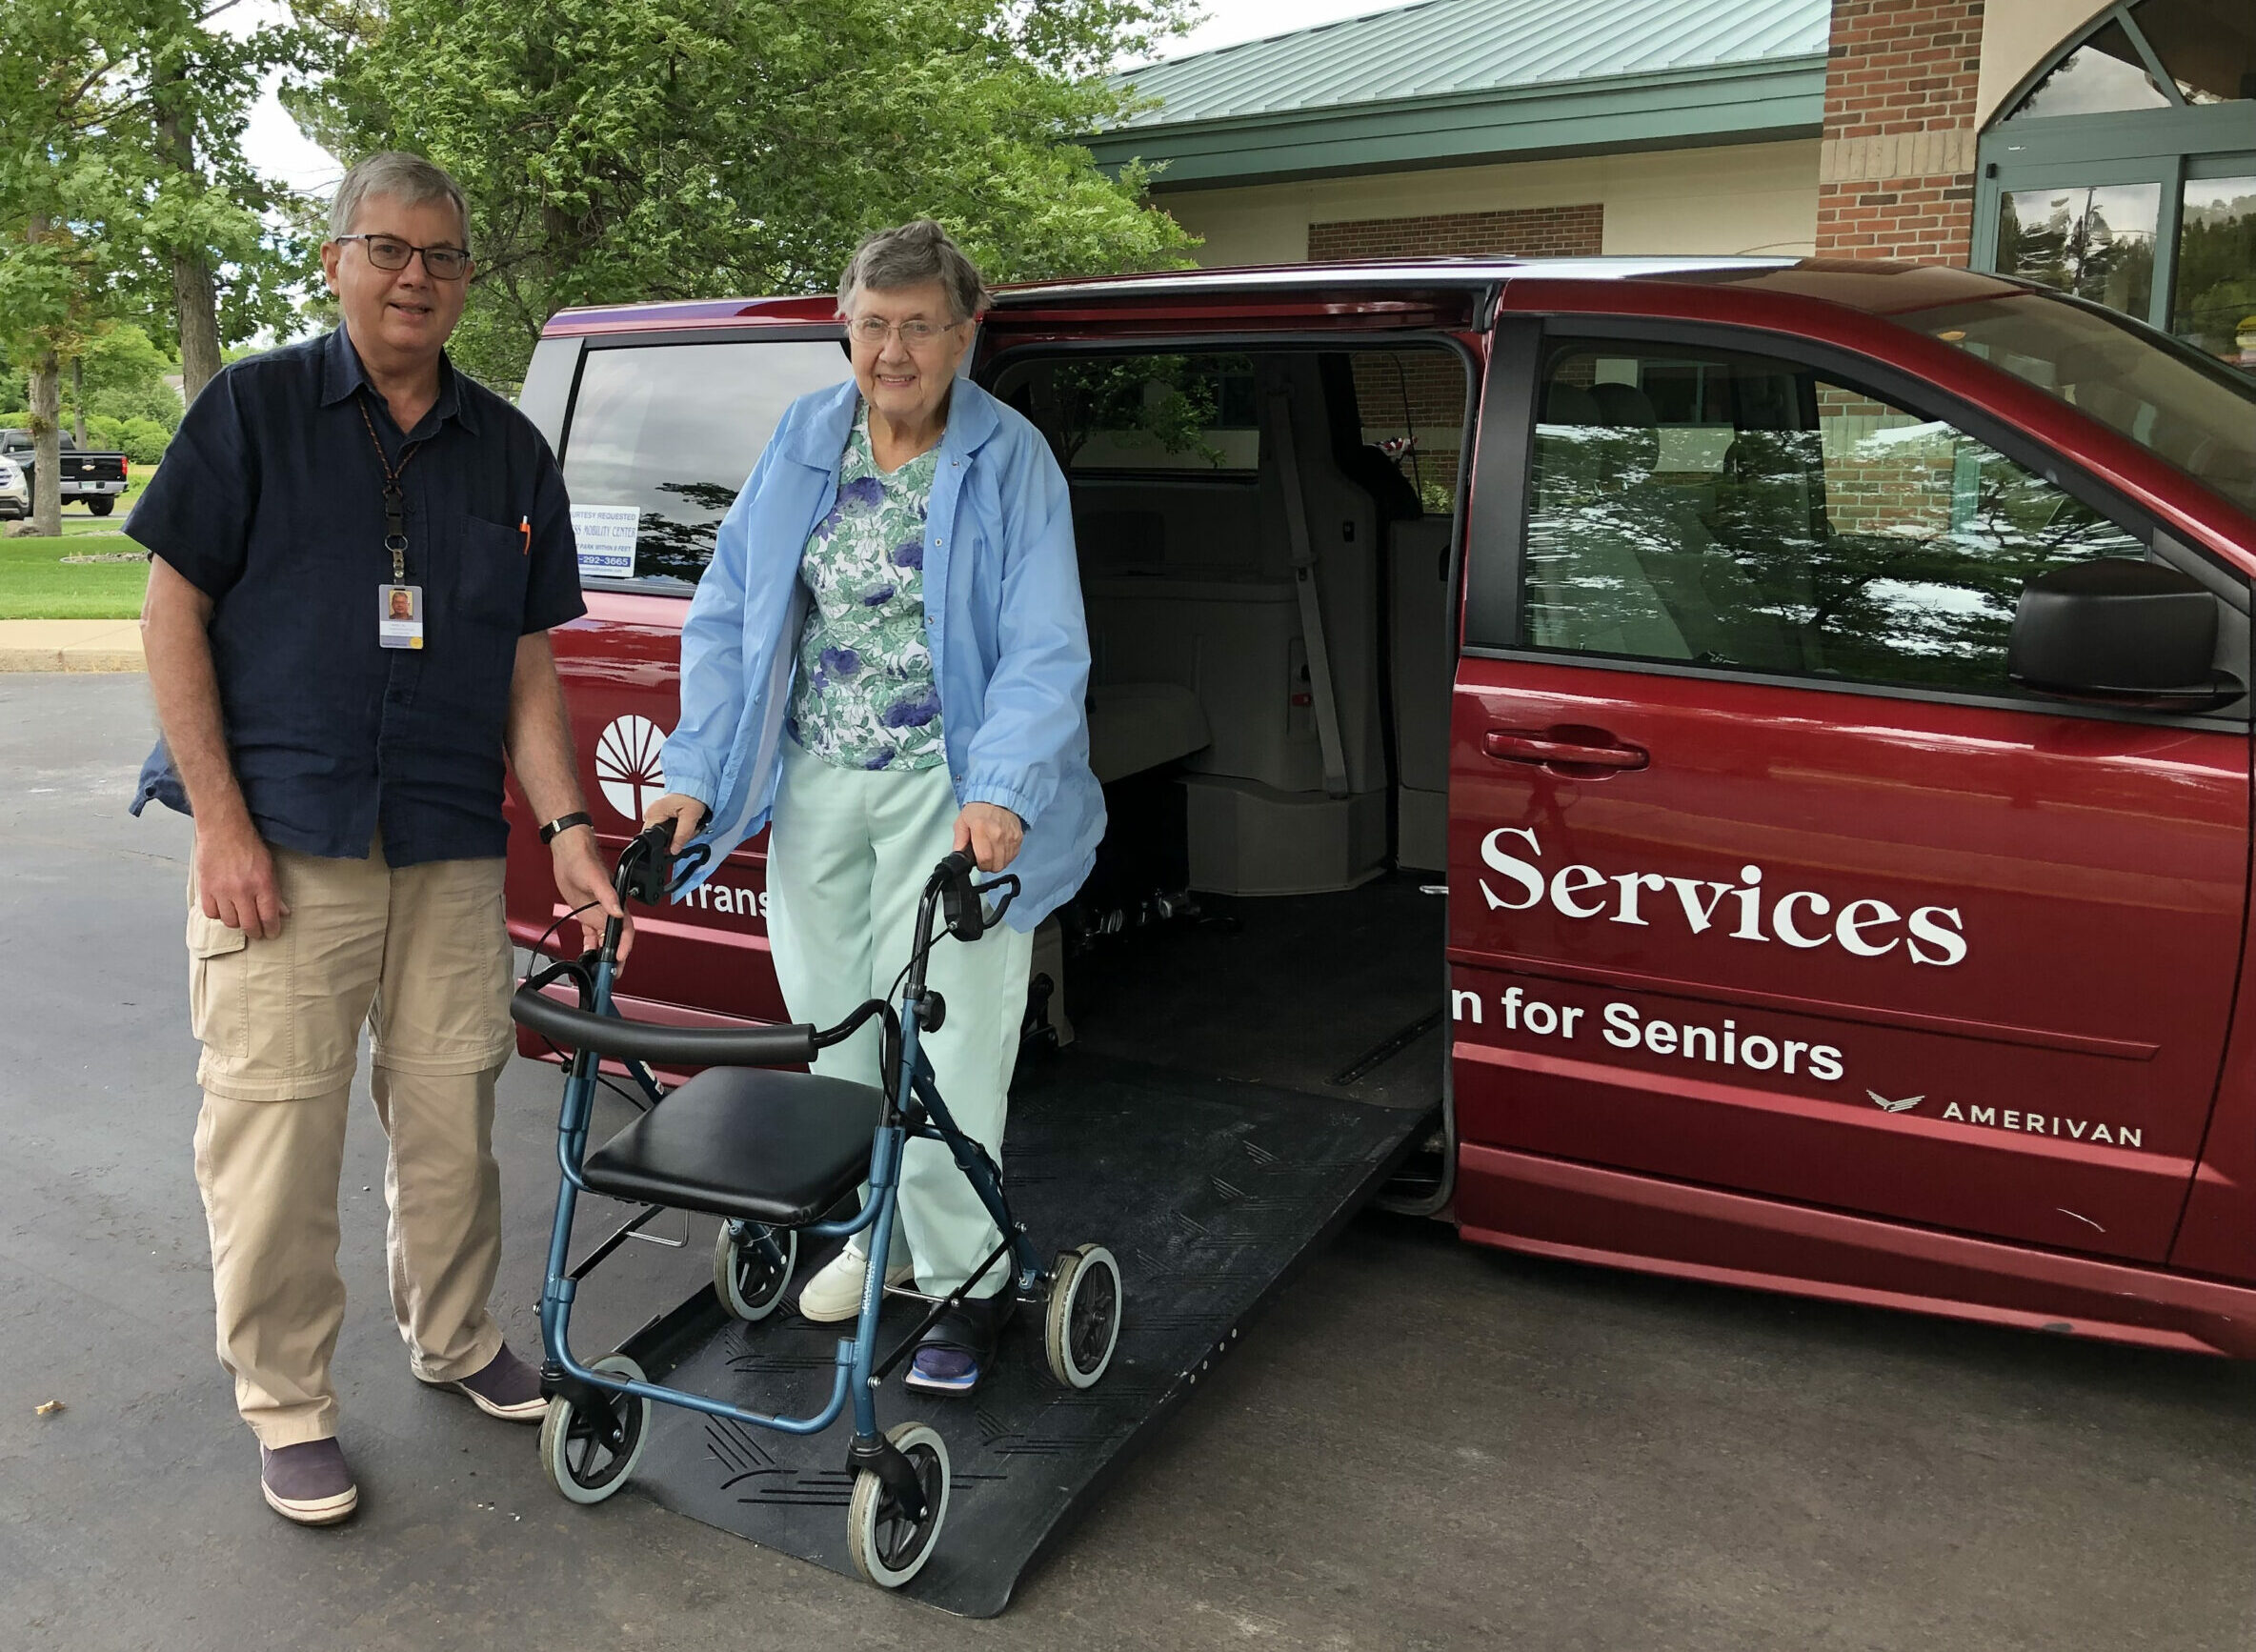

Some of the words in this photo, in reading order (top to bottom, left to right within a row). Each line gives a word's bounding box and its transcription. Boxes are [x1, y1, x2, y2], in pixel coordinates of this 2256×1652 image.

[571, 511, 595, 519] URTESY
[597, 512, 636, 520] REQUESTED
[584, 525, 610, 536] MOBILITY
[613, 527, 636, 537] CENTER
[1479, 826, 1967, 966] Services
[1451, 989, 1482, 1024] n
[1501, 986, 1584, 1038] for
[1602, 1002, 1843, 1080] Seniors
[1943, 1101, 2142, 1147] AMERIVAN
